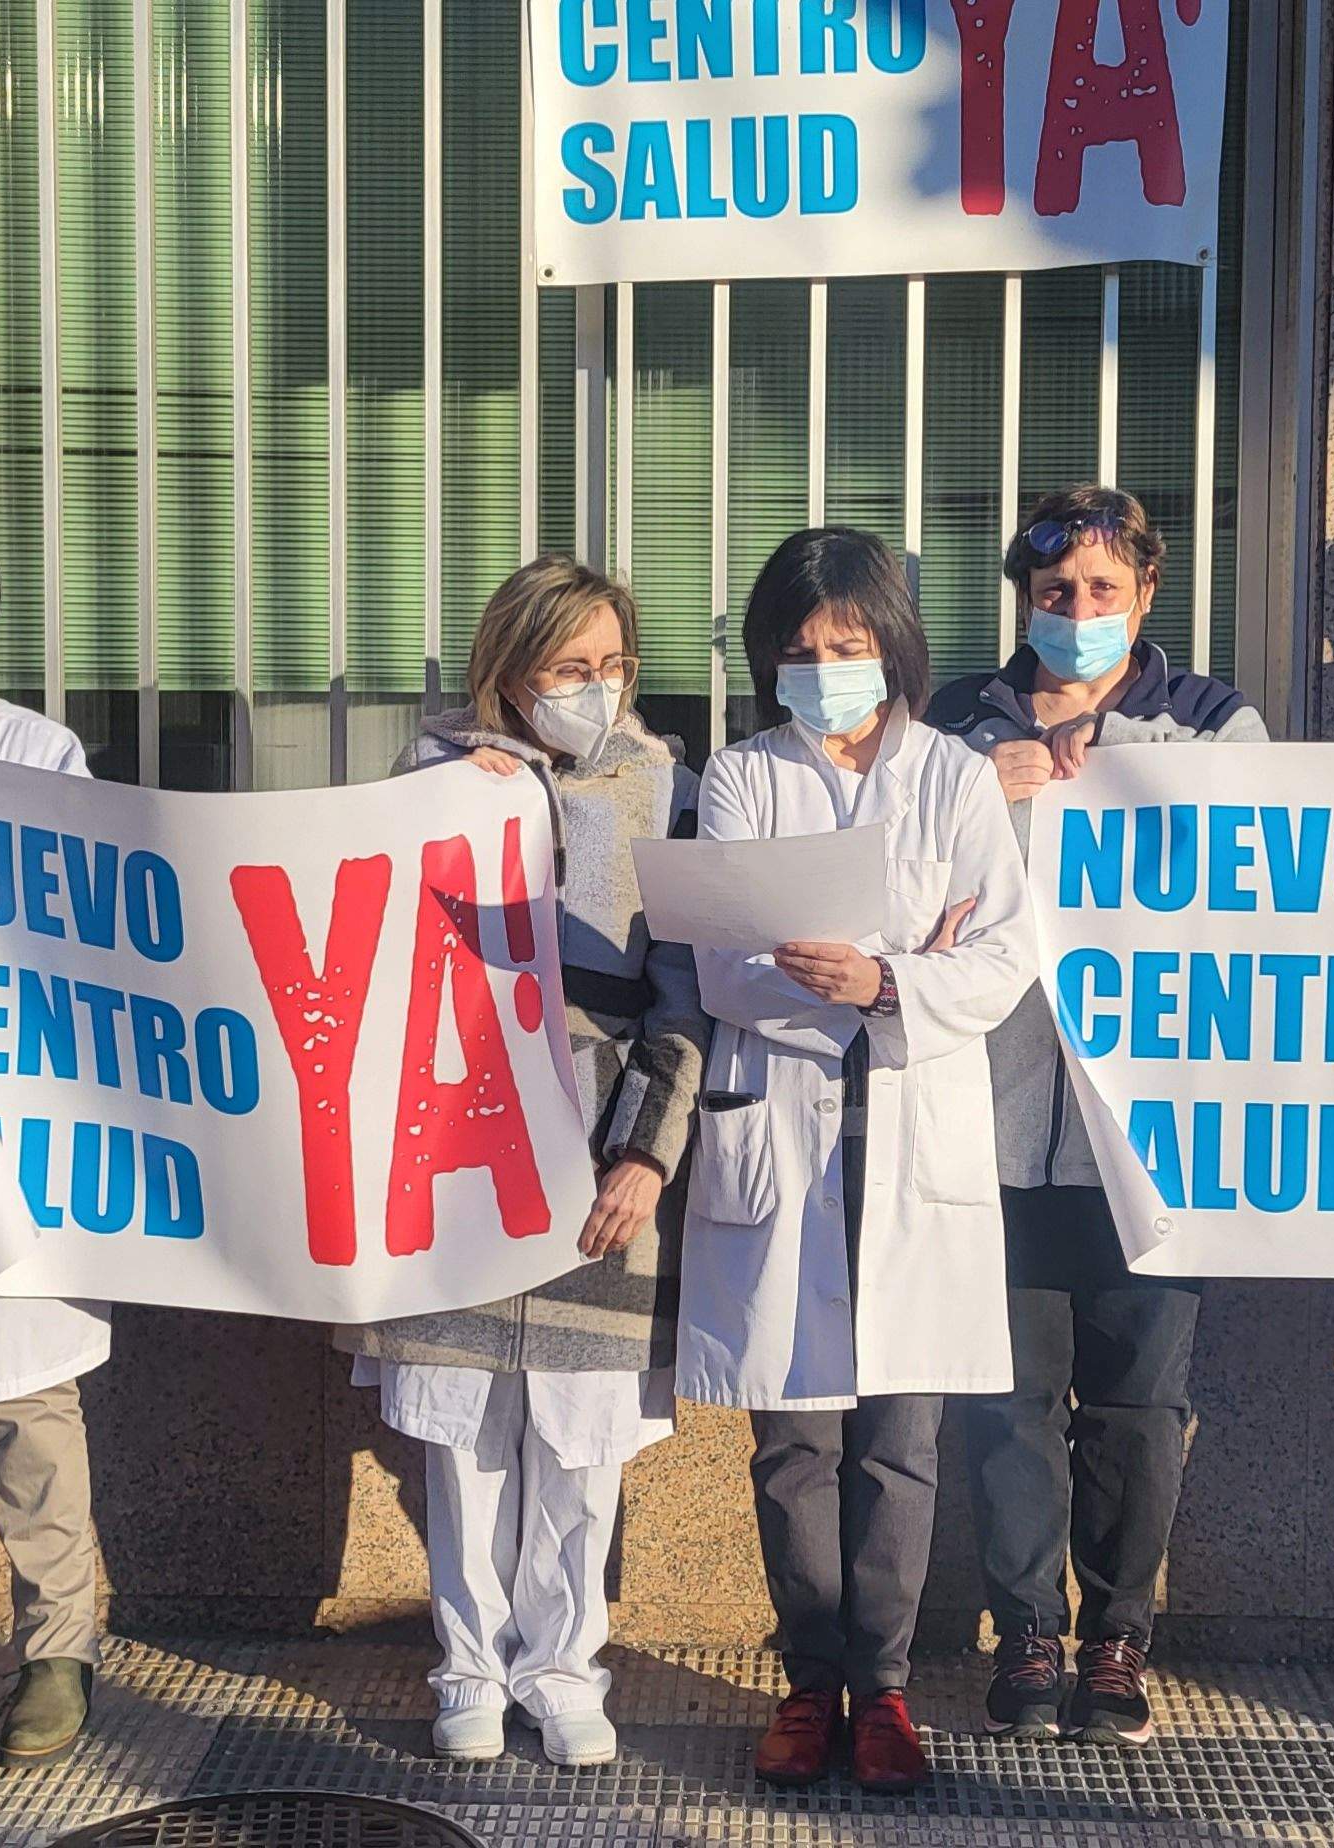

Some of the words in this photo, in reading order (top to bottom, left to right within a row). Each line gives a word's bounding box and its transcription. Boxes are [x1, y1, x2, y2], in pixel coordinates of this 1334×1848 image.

[558, 0, 927, 87] CENTRO
[561, 114, 859, 224] SALUD
[230, 816, 552, 1267] YA!
